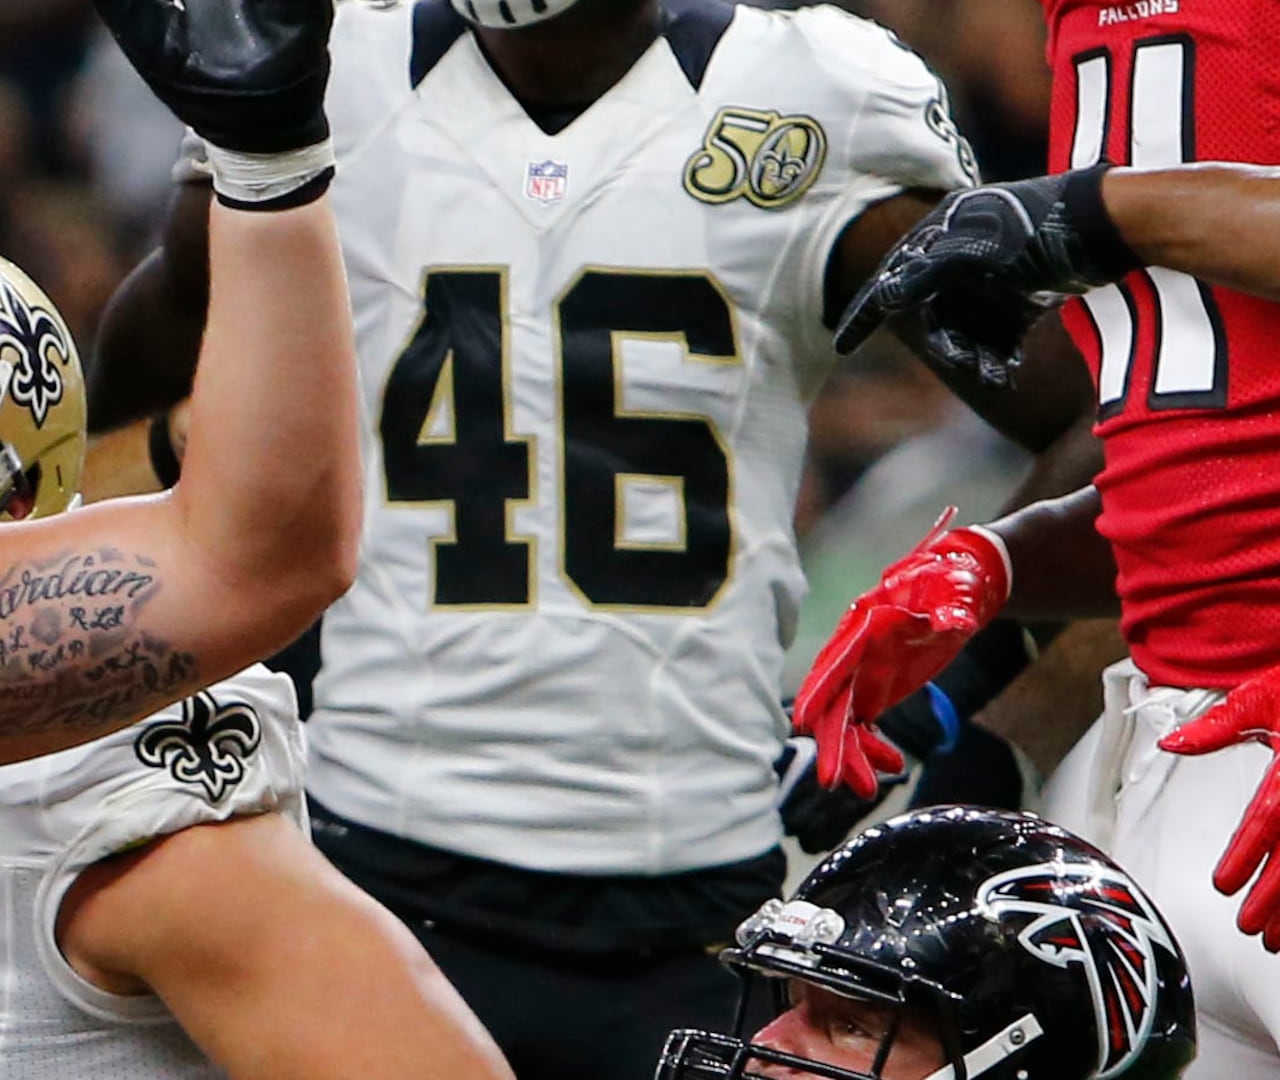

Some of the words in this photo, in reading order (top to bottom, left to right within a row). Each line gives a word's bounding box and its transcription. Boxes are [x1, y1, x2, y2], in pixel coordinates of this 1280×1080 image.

[682, 106, 828, 211] 50
[1069, 33, 1228, 422] 11
[378, 262, 744, 617] 46
